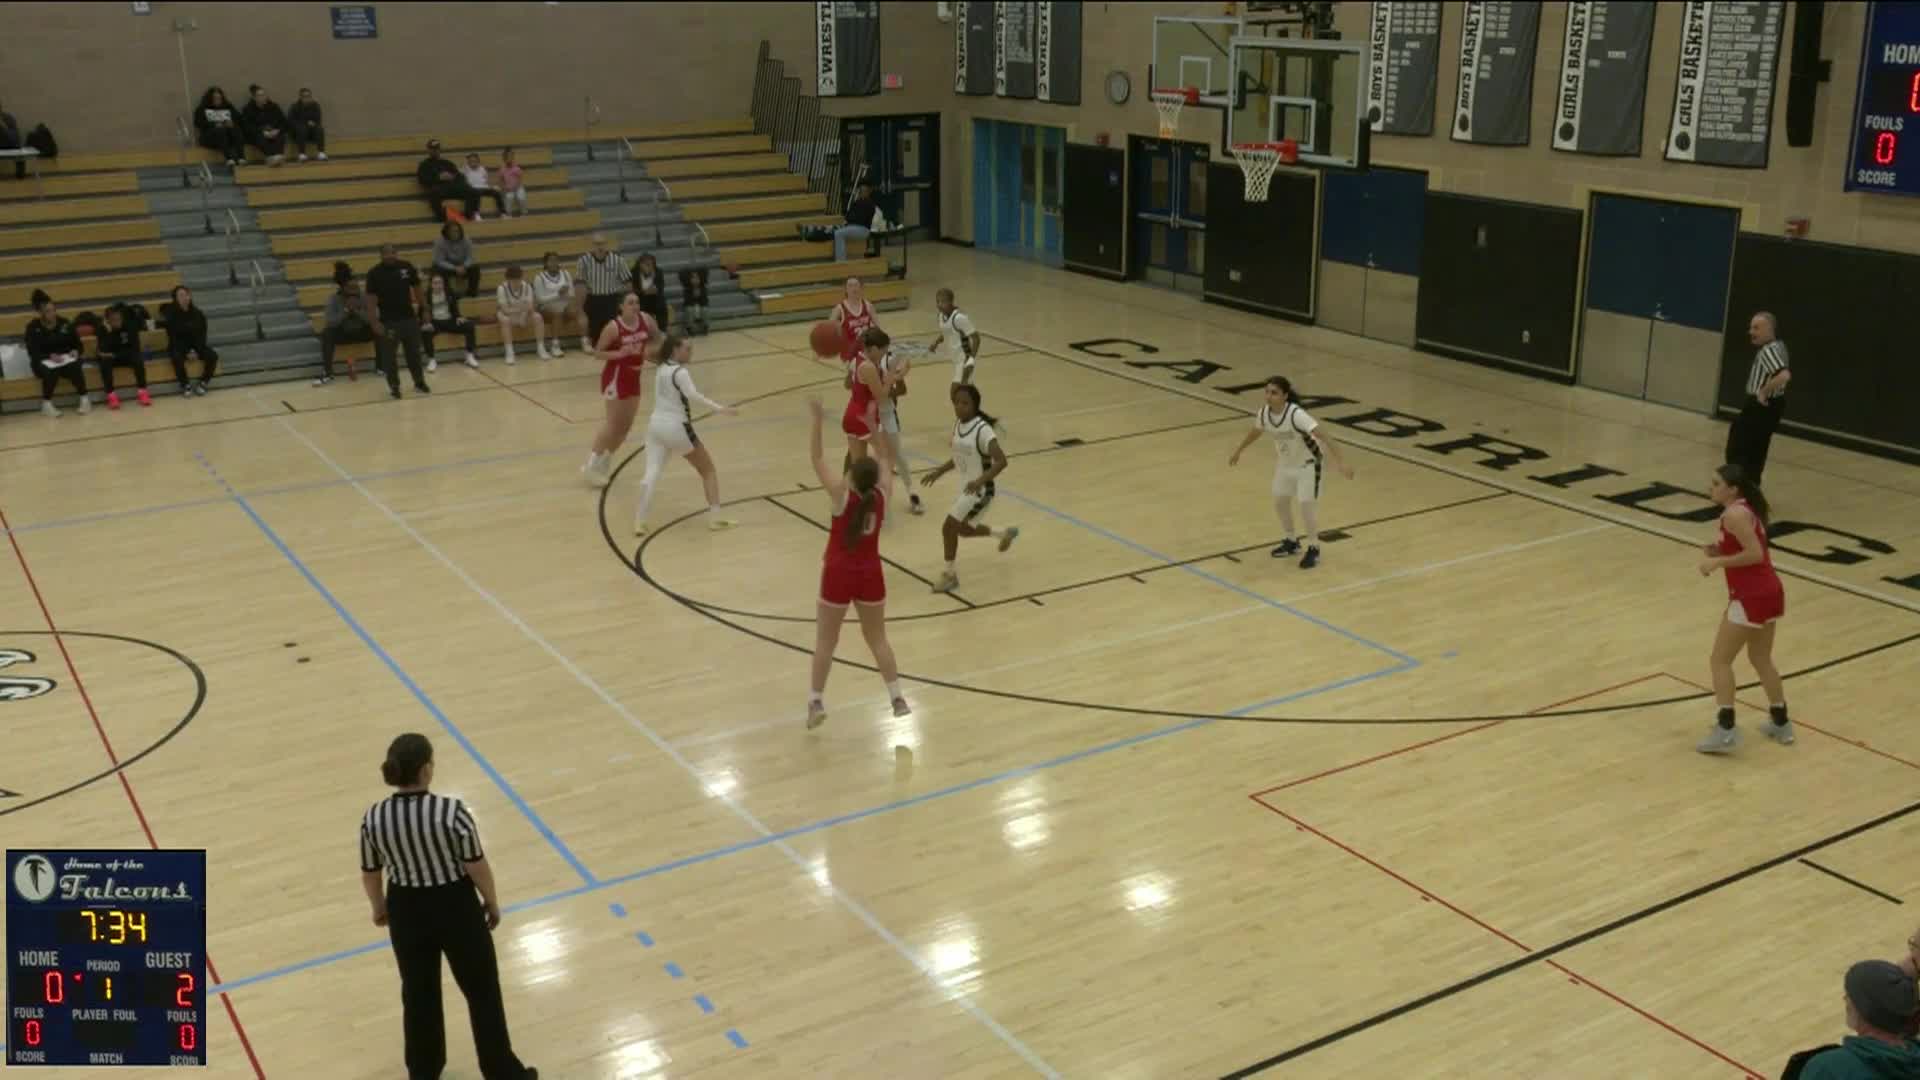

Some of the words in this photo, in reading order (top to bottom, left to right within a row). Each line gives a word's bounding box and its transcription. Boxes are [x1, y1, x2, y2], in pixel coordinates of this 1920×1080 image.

[1371, 66, 1383, 101] BOYS
[1563, 74, 1580, 119] GIRLS
[1865, 115, 1904, 131] FOULS
[1876, 132, 1895, 164] 0
[1858, 169, 1896, 186] SCORE
[1068, 338, 1920, 591] CAMBRIDG
